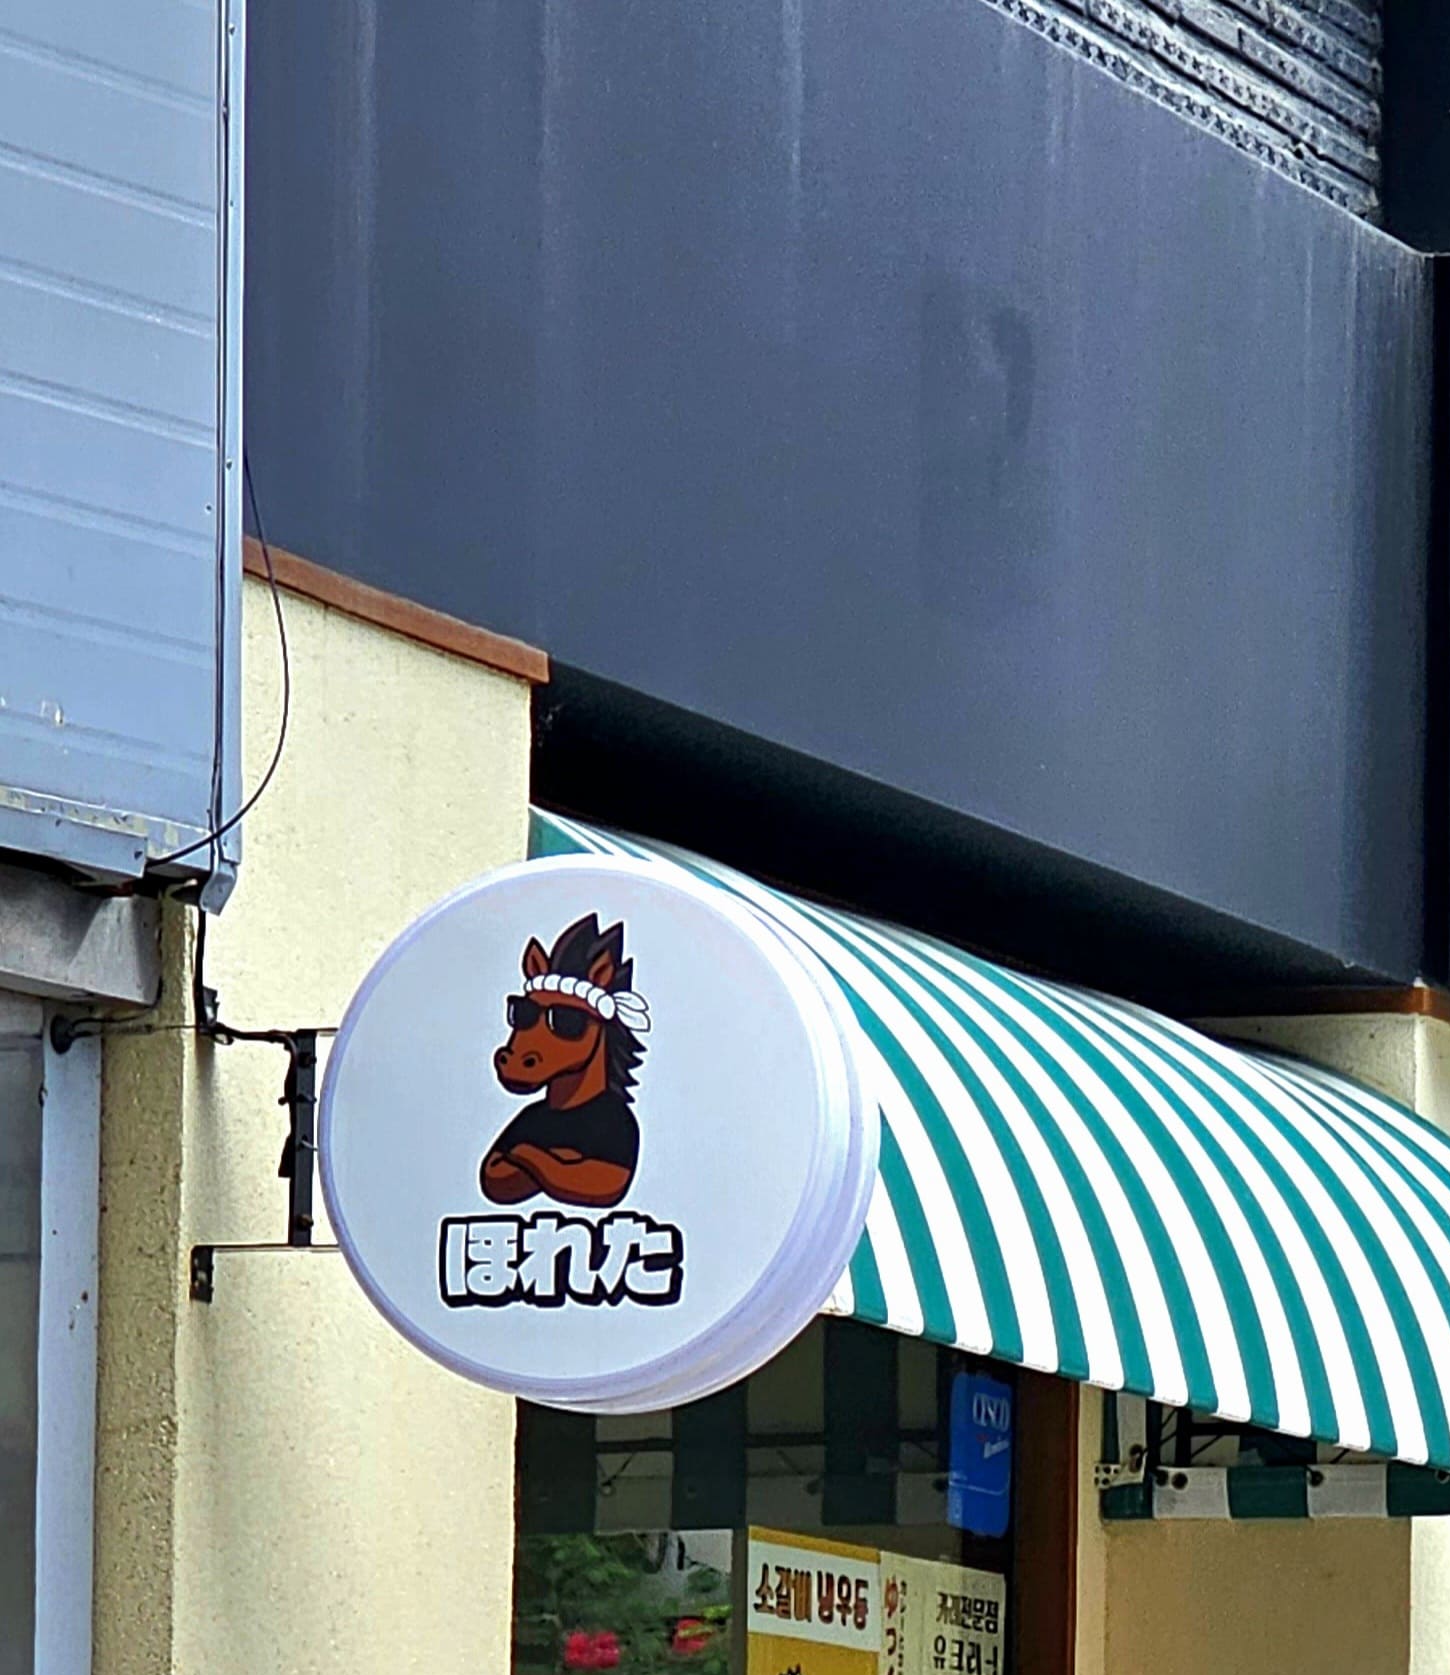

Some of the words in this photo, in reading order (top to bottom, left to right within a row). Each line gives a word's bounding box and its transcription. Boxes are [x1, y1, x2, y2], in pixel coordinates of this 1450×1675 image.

[439, 1211, 684, 1308] ほれた
[753, 1563, 812, 1623] 소갈비
[816, 1570, 869, 1630] 냉우동
